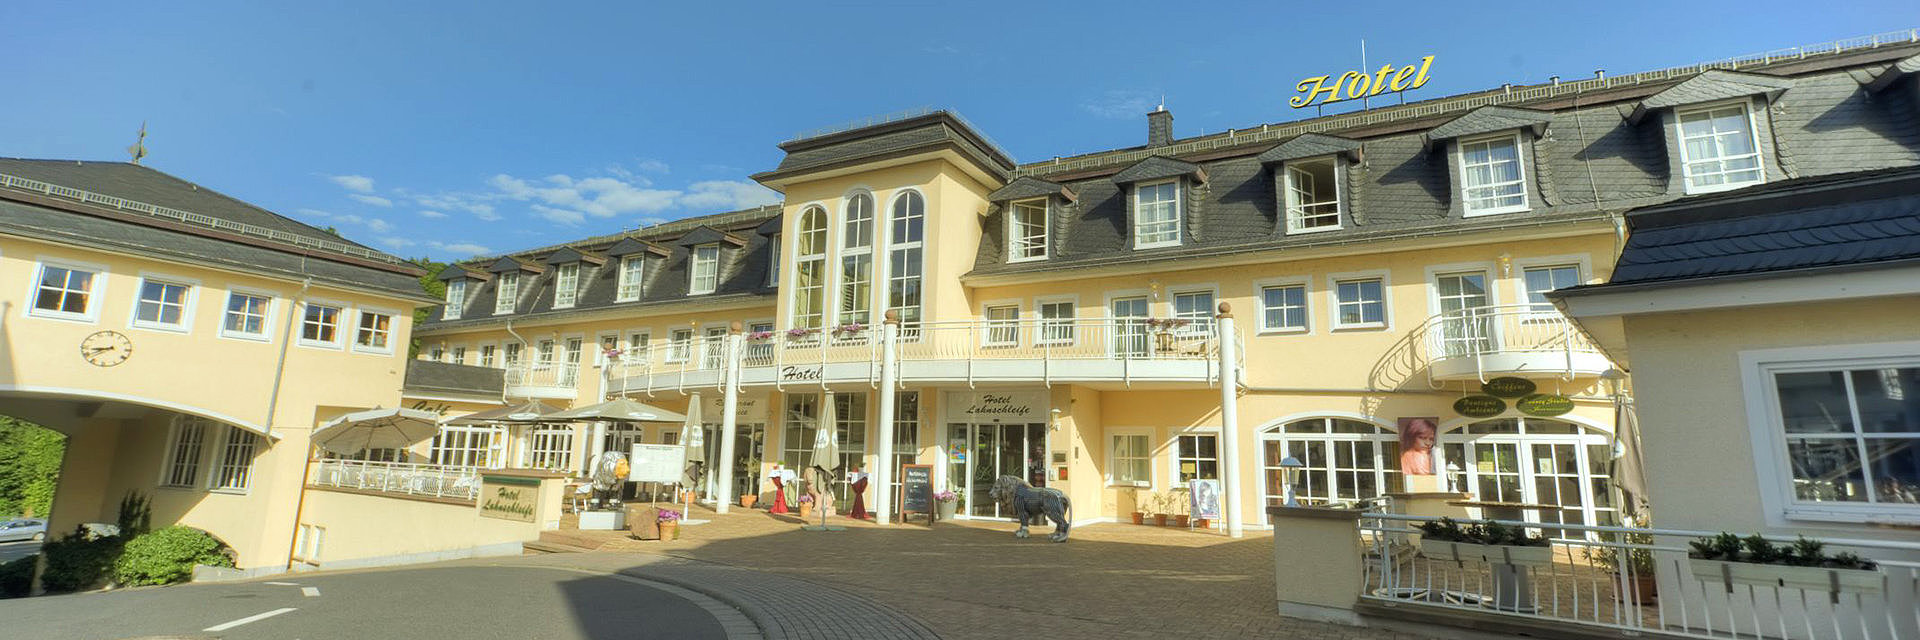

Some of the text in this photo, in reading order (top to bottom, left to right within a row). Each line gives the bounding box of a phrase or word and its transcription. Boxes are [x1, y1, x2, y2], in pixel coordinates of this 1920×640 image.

[1289, 54, 1435, 109] Hotel
[782, 365, 823, 381] Hotel
[983, 394, 1012, 404] Hotel
[966, 404, 1032, 417] Lahnschleife
[497, 487, 521, 501] Hotel
